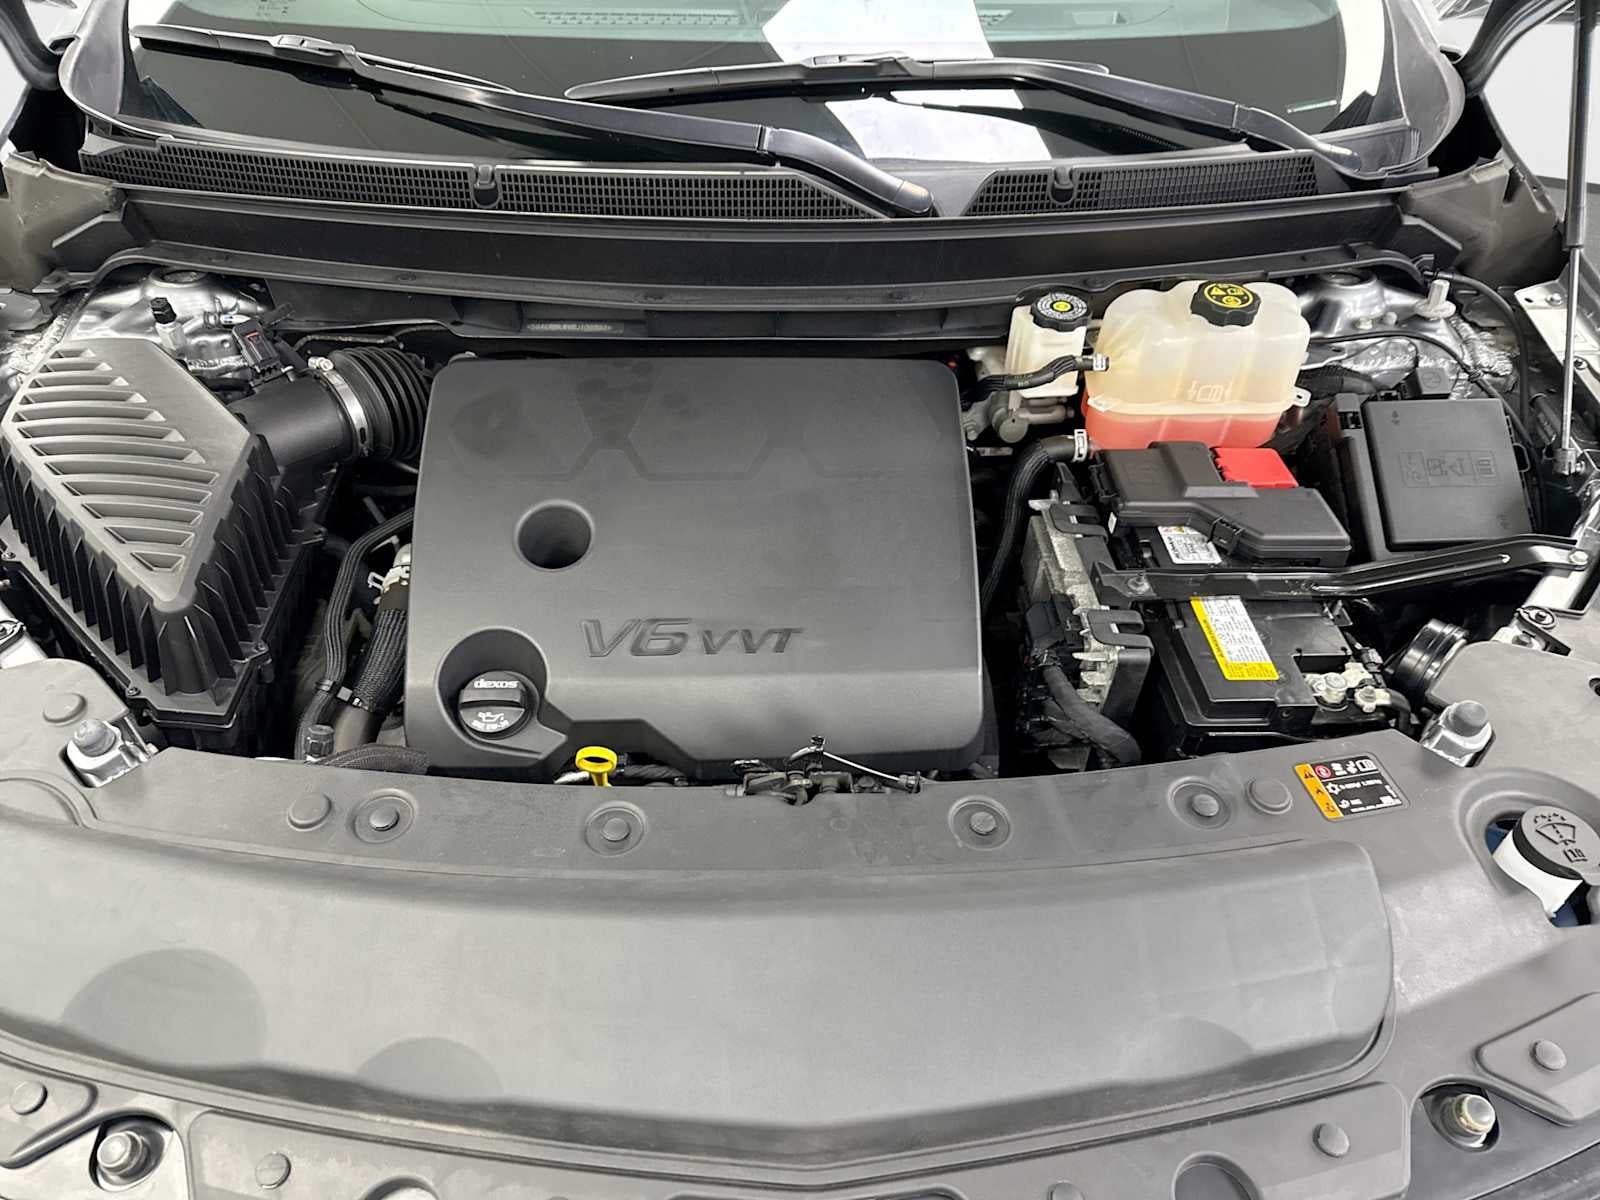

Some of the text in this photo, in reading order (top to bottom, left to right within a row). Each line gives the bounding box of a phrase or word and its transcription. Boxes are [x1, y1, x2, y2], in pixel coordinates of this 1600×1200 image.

[580, 617, 803, 657] V6 VVT
[473, 678, 519, 689] dexos
